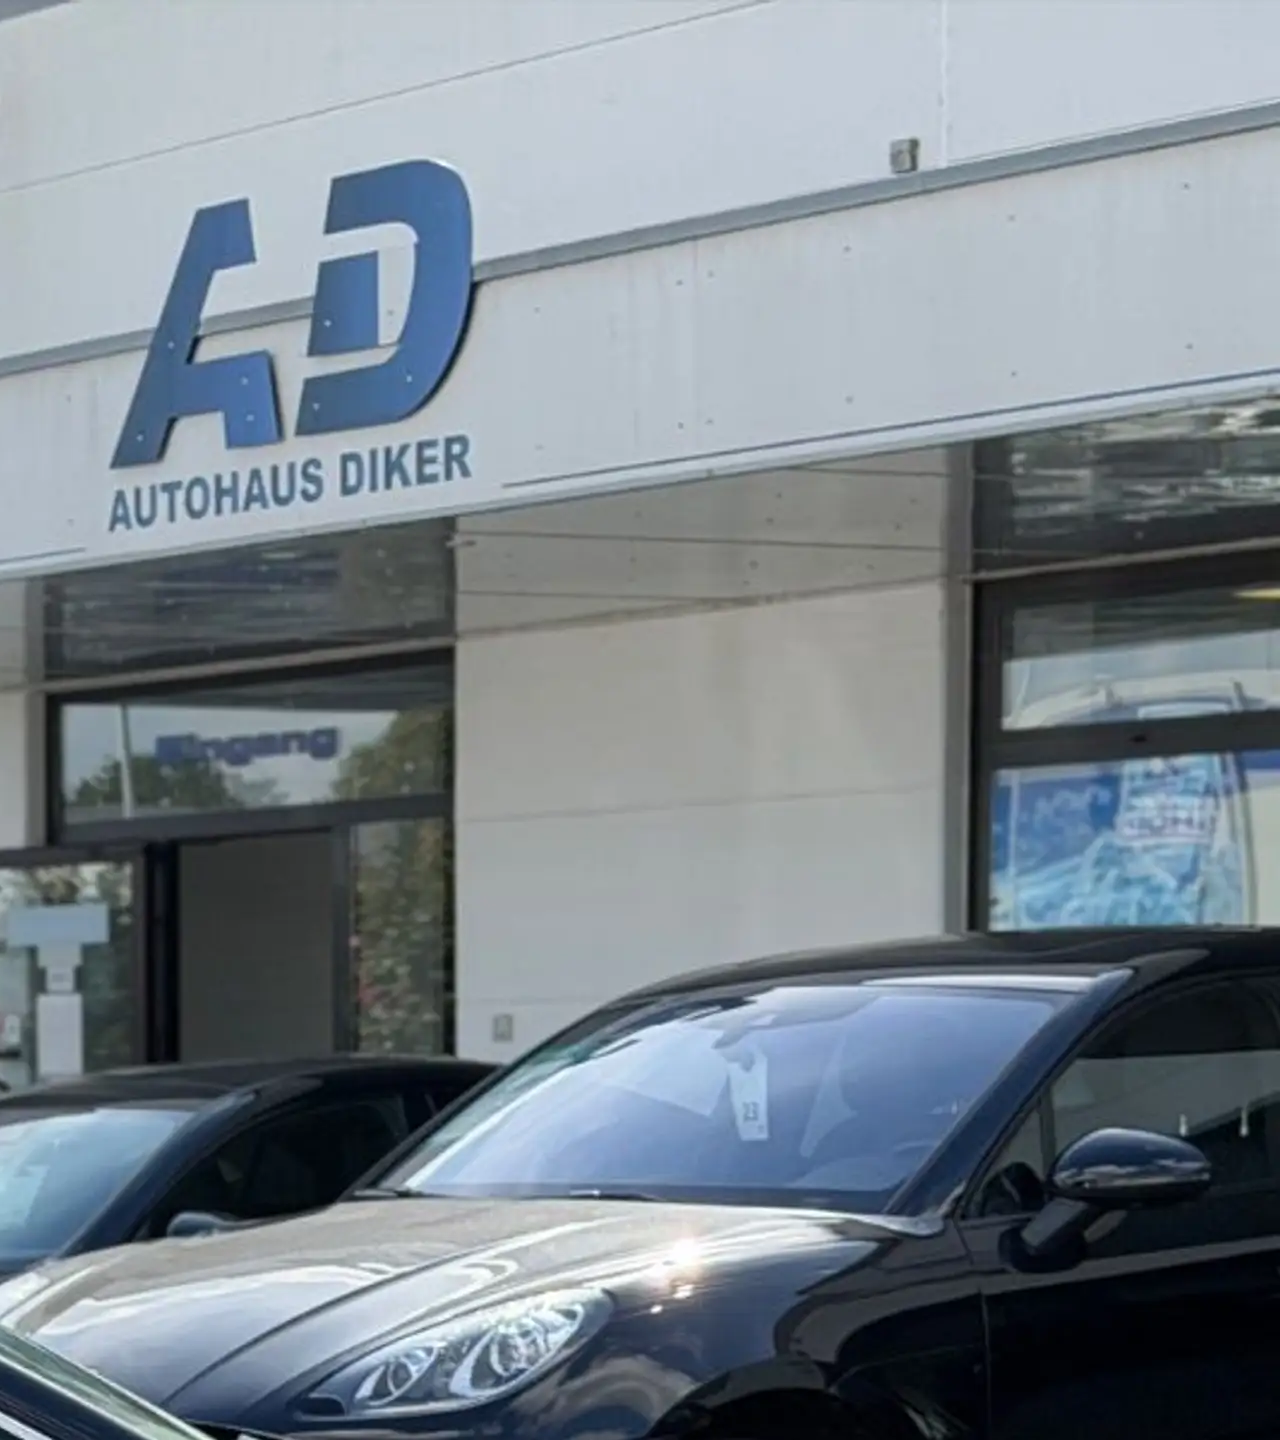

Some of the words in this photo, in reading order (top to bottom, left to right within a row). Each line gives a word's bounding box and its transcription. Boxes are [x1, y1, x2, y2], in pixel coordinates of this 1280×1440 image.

[110, 159, 474, 468] AD
[108, 457, 324, 533] AUTOHAUS
[340, 433, 472, 499] DIKER
